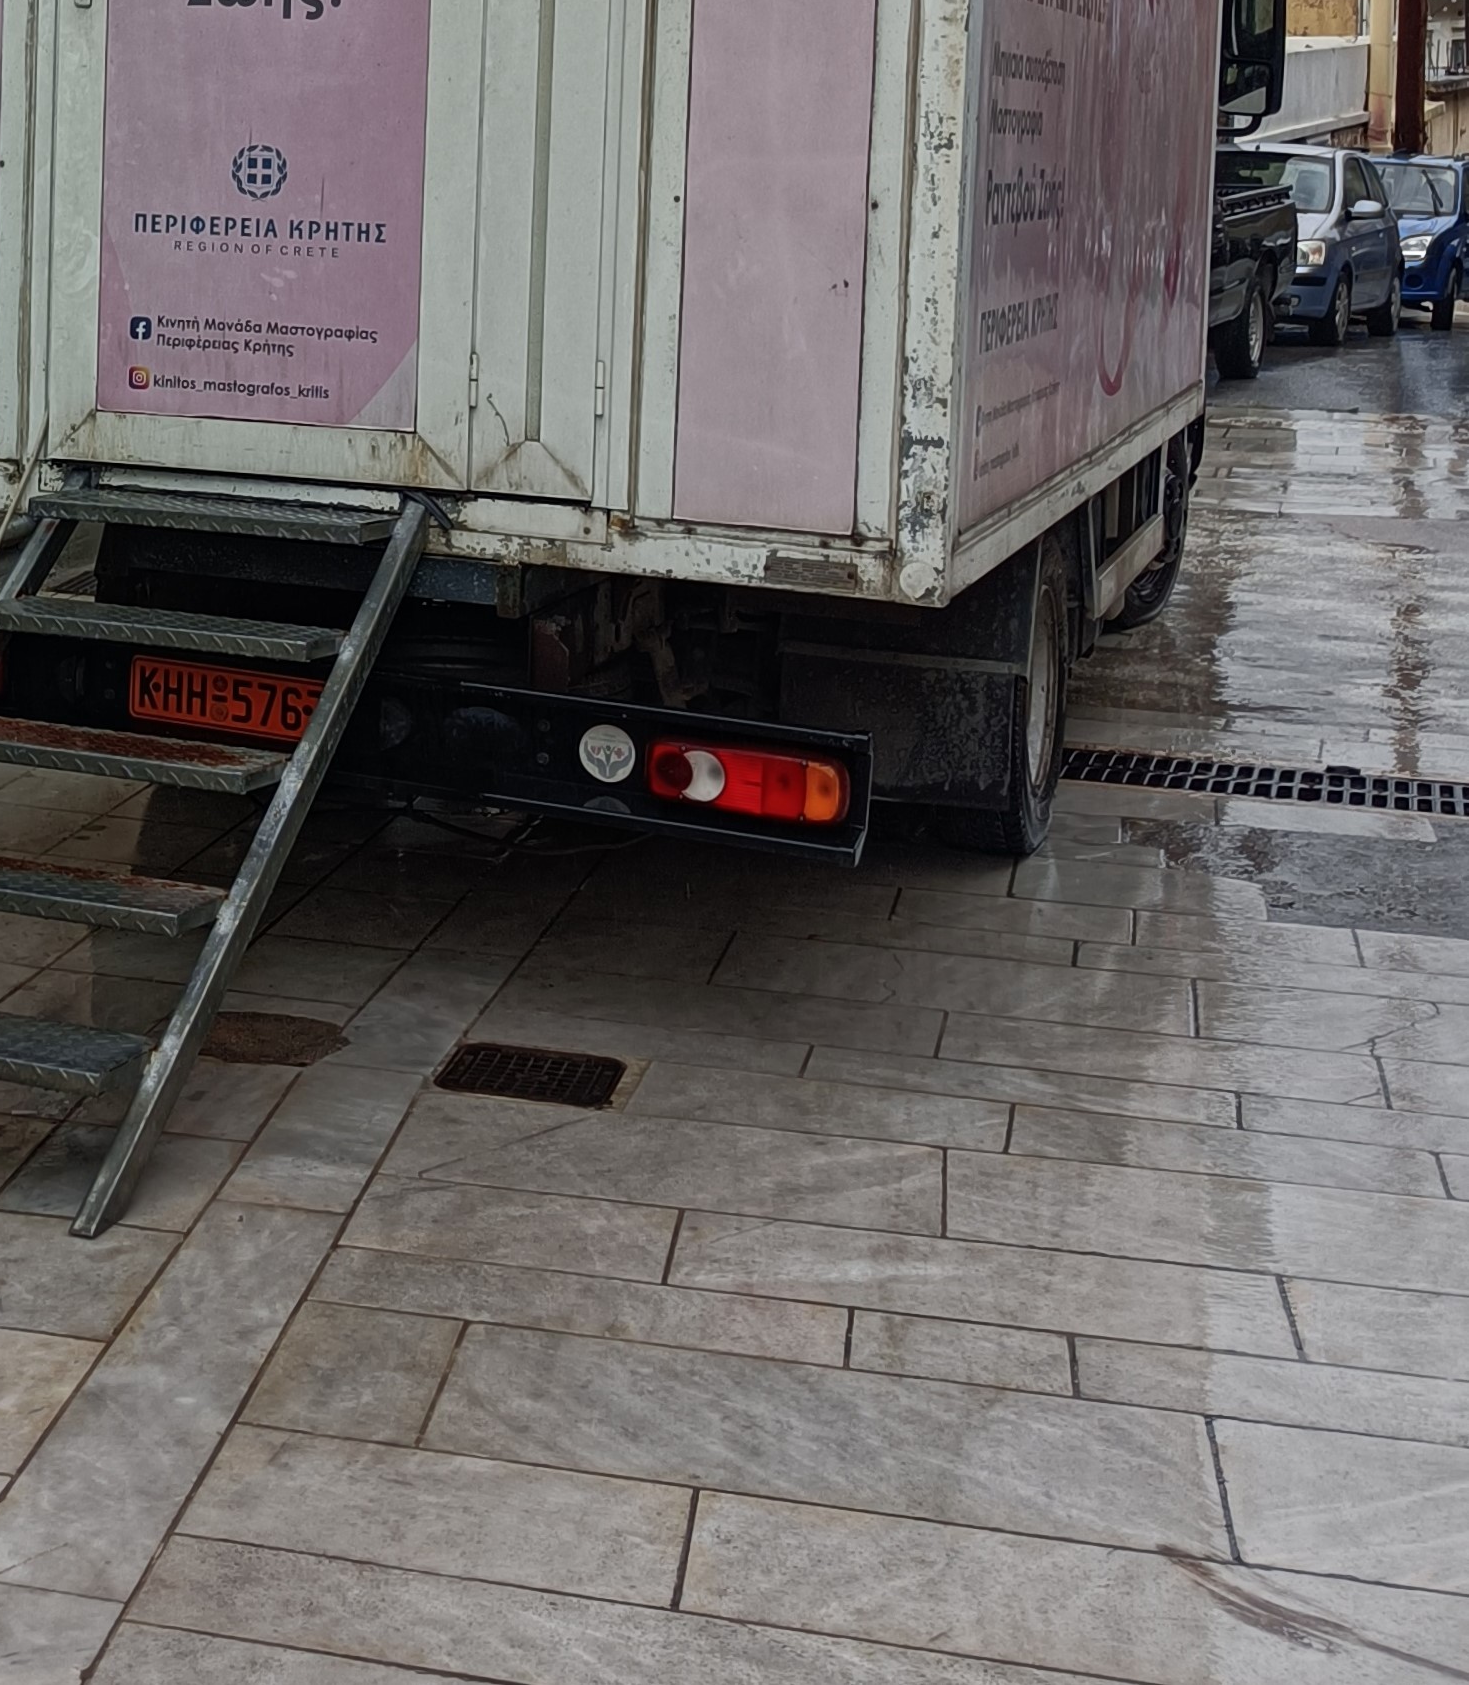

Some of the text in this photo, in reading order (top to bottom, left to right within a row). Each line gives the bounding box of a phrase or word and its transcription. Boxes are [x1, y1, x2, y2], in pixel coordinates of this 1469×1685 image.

[985, 163, 1036, 237] Ραντεβού
[134, 213, 387, 243] ΠΕΡΙΦΕΡΕΙΑ ΚΡΗΤΗΣ
[174, 240, 339, 258] REGION OF CRETE
[157, 315, 378, 344] Κινητή Μονάδα Μαστογραφίας
[244, 337, 294, 357] Κρήτης
